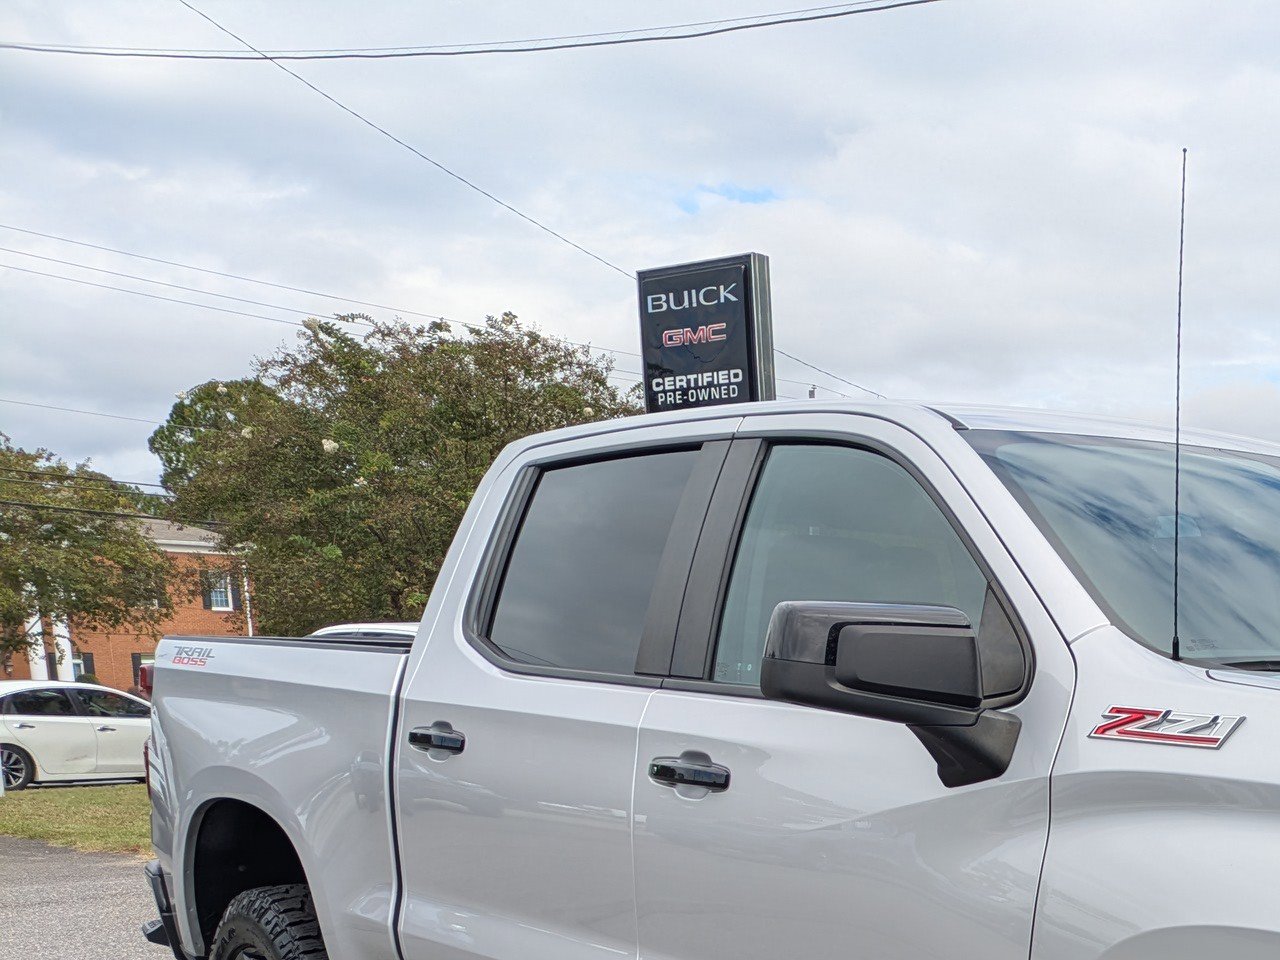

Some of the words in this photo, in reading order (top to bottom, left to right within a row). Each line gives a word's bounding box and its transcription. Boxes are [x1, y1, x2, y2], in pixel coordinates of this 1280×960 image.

[647, 283, 738, 313] BUICK
[662, 322, 727, 347] GMC
[652, 369, 743, 392] CERTIFIED
[658, 385, 738, 405] PRE-OWNED
[172, 656, 208, 666] BOSS
[174, 646, 215, 658] TRAIL
[1087, 704, 1247, 750] Z71
